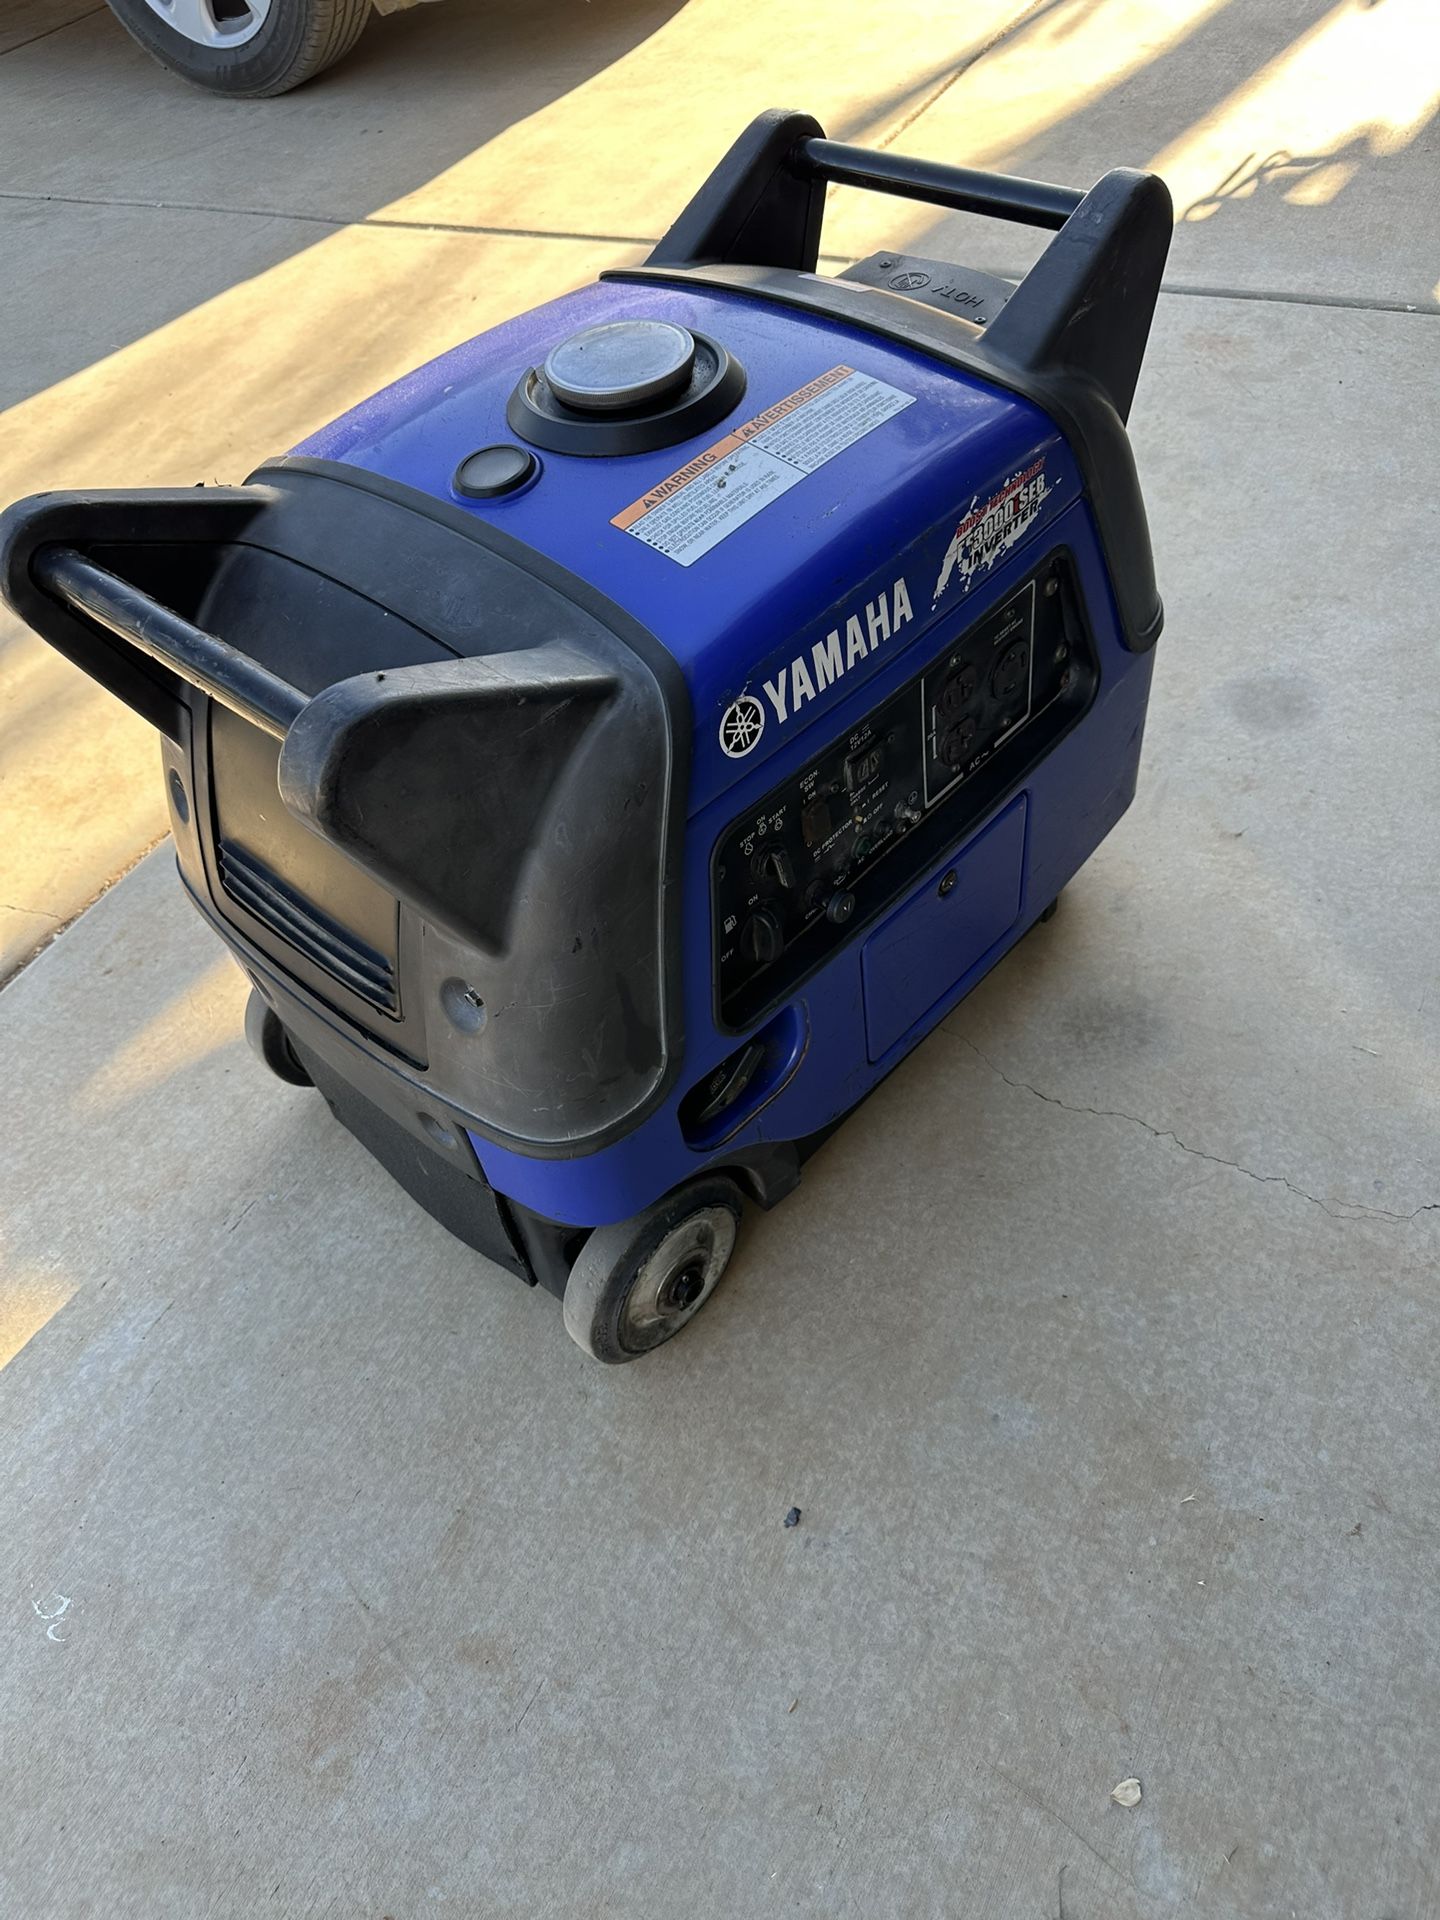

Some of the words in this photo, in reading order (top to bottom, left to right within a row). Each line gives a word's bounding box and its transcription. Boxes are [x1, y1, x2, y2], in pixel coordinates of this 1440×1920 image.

[932, 285, 984, 308] HOT!
[751, 366, 853, 430] AVERTISSEMENT
[651, 452, 718, 499] WARNING
[967, 500, 1038, 569] INVERTER
[763, 577, 913, 724] YAMAHA
[969, 756, 980, 771] AC
[800, 770, 820, 789] ECON.
[768, 804, 788, 825] START
[739, 832, 756, 848] STOP
[822, 818, 853, 850] PROTECTOR
[747, 894, 759, 906] ON
[720, 947, 736, 962] OFF
